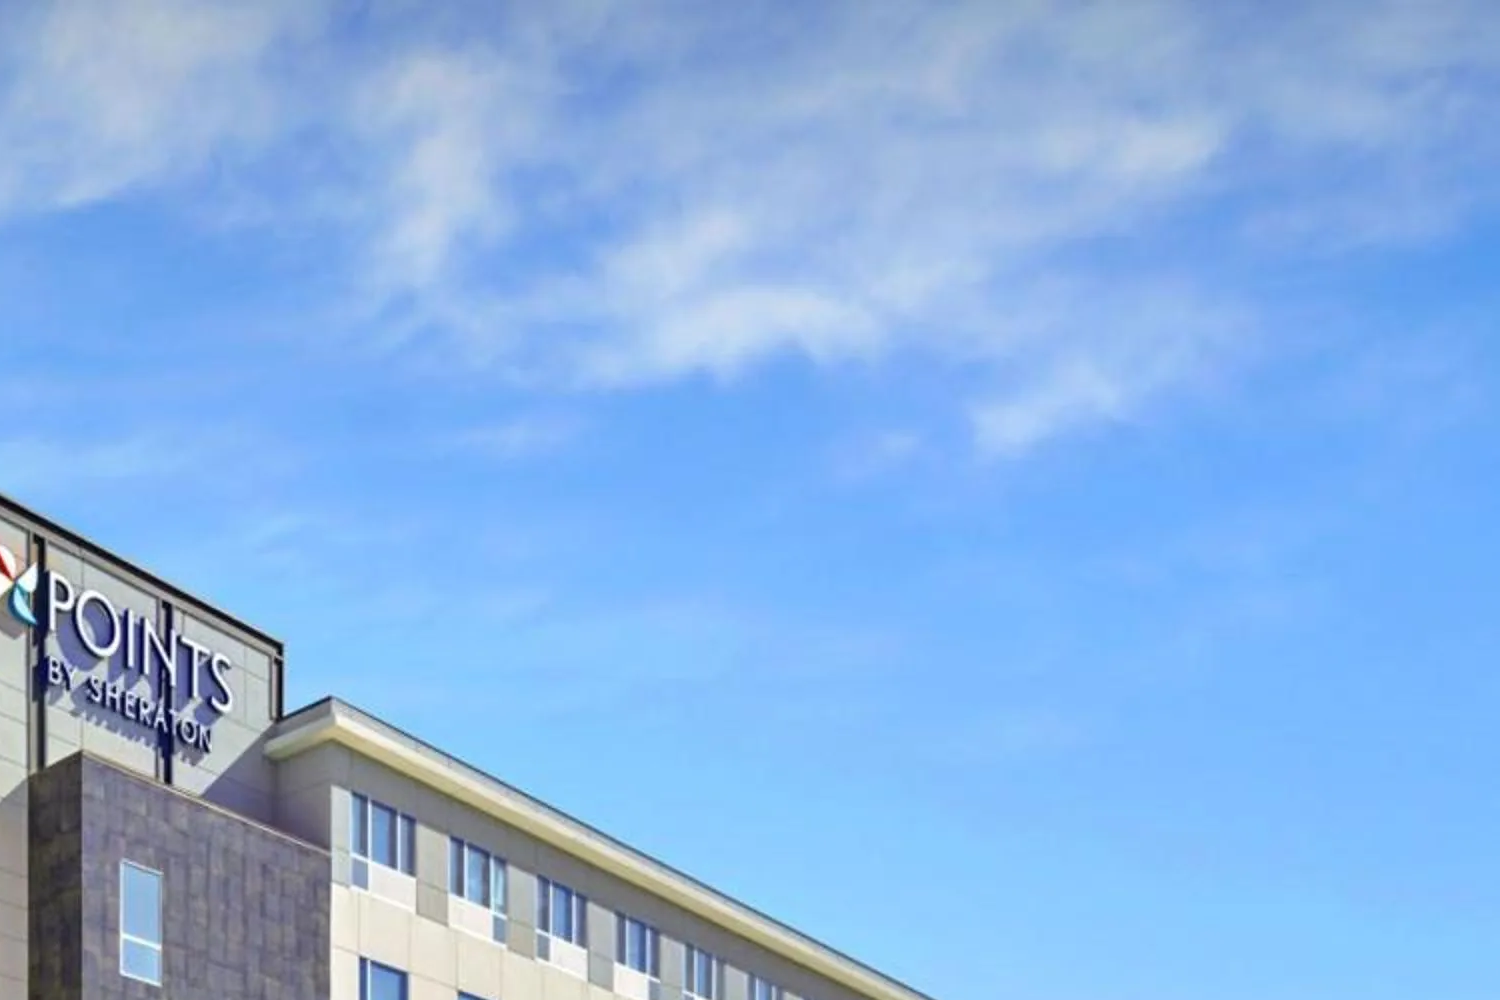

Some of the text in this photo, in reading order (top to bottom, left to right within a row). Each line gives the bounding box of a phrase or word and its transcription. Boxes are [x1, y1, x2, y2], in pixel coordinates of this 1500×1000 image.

[47, 570, 234, 715] POINTS
[47, 655, 213, 754] BY SHERATON
